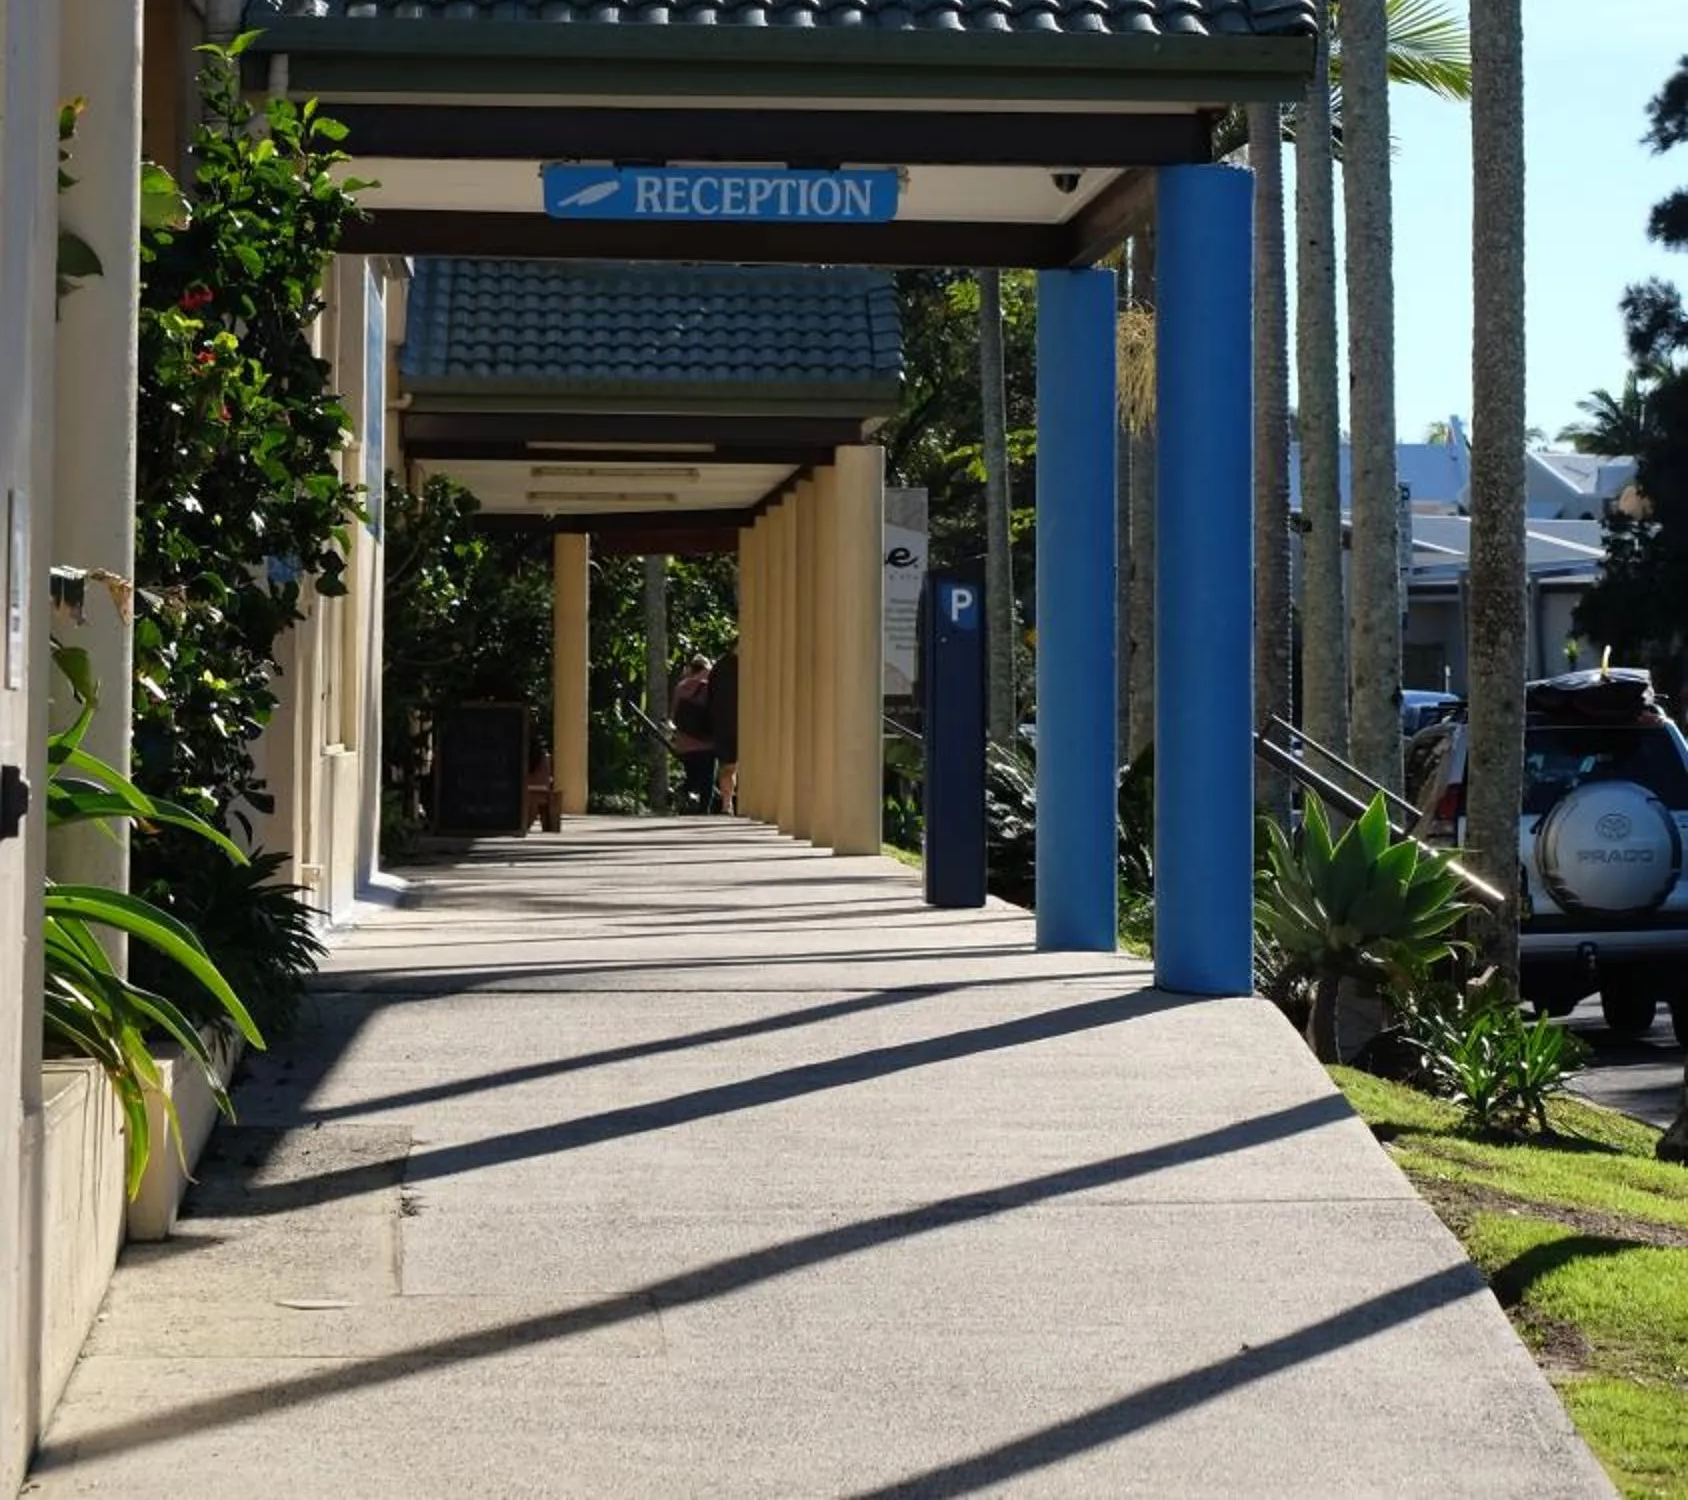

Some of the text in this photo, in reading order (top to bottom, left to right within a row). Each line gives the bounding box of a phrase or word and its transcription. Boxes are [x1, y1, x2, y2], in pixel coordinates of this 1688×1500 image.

[634, 176, 873, 217] RECEPTION
[951, 588, 973, 622] P
[1576, 848, 1653, 864] PRADO
